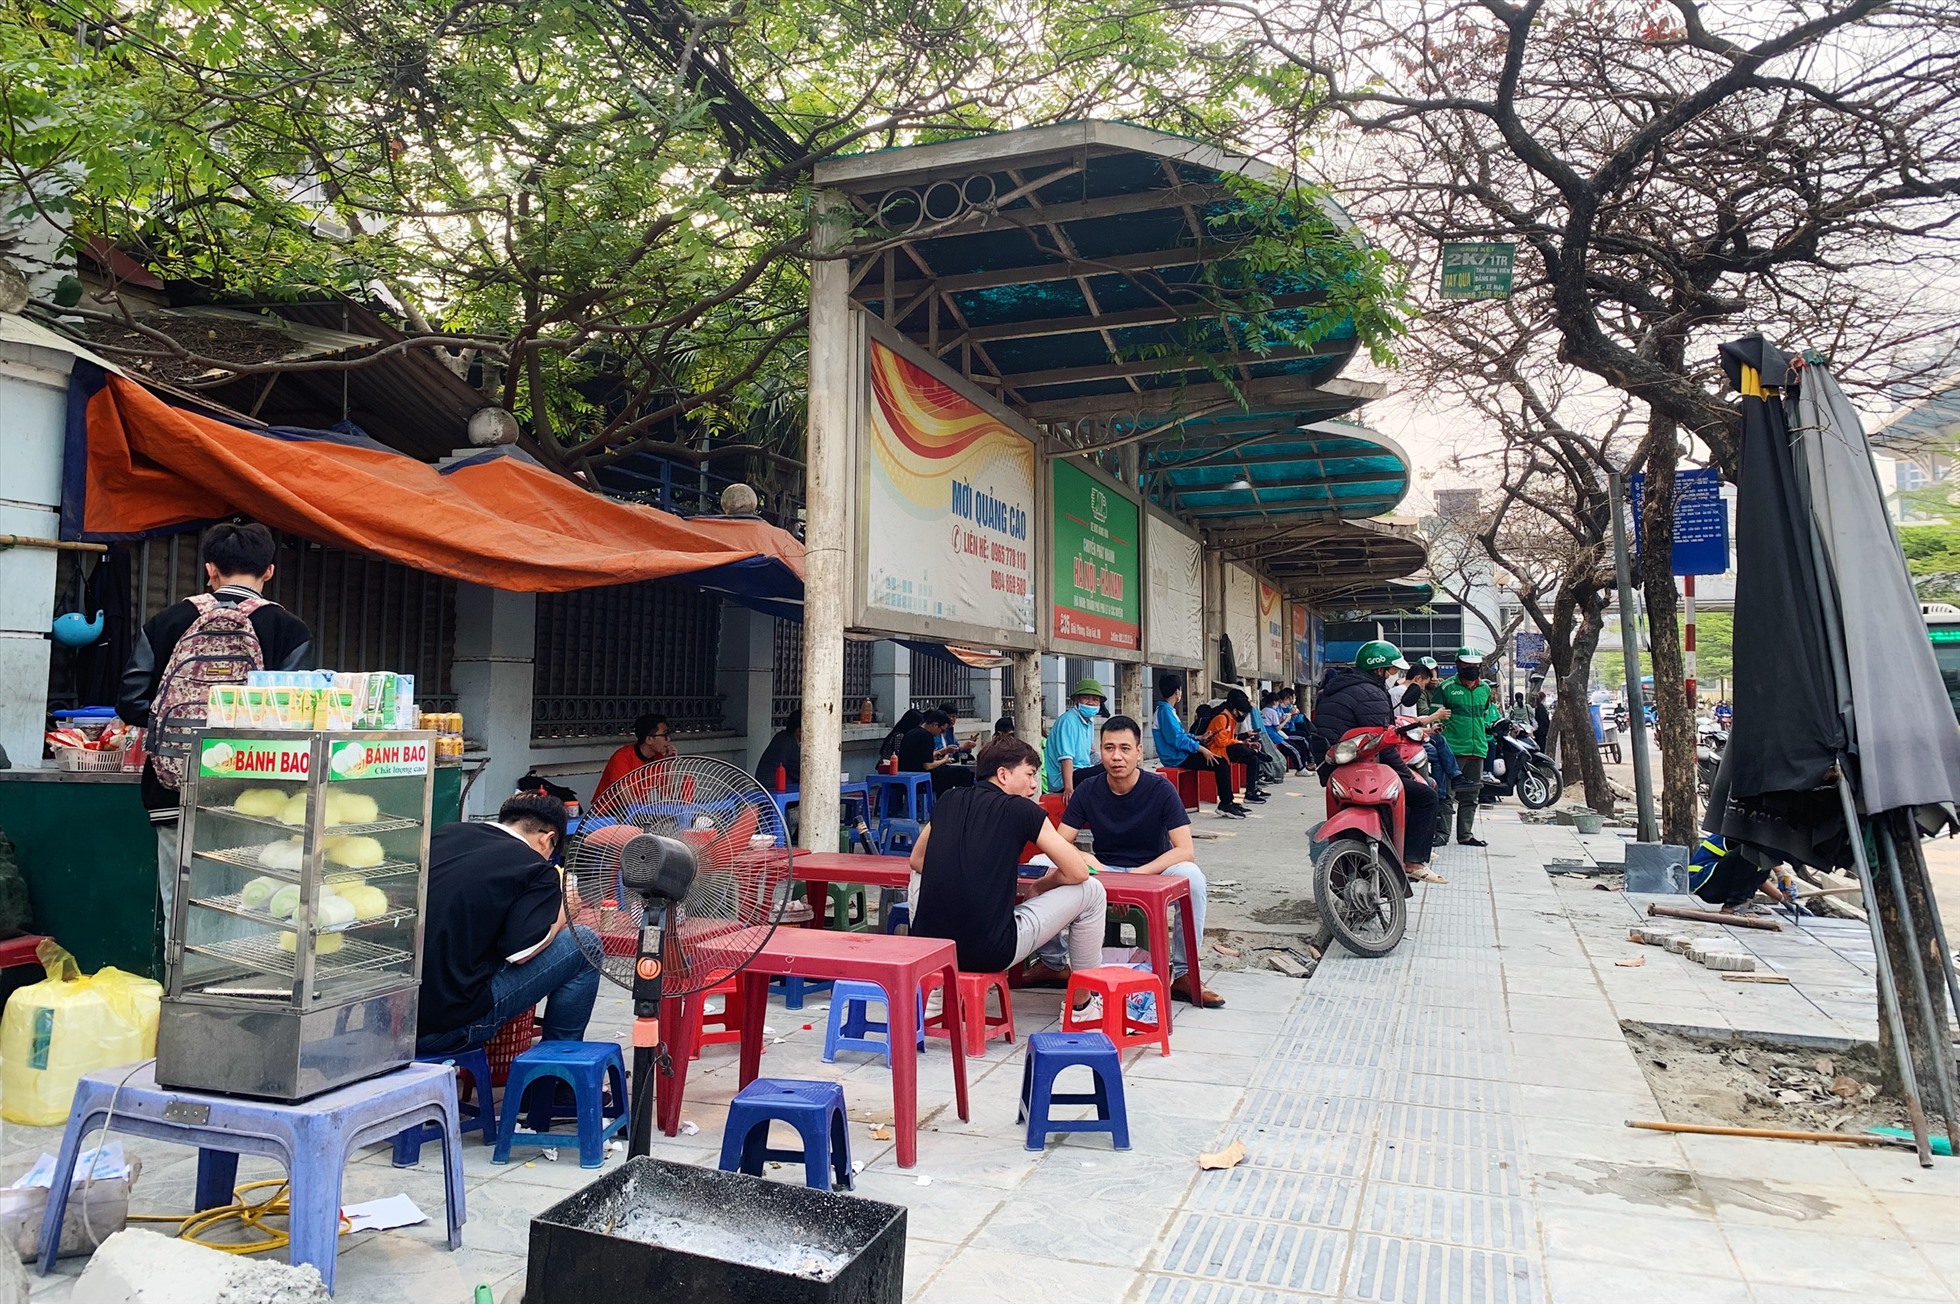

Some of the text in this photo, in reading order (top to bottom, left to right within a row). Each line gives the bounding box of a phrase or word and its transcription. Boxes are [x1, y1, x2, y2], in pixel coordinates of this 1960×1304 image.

[1444, 274, 1457, 287] VAY
[952, 476, 1026, 541] MỜI QUẢNG CÁO
[963, 530, 977, 556] LIÊN
[1073, 552, 1084, 589] HÀ
[1084, 557, 1096, 598] NỘI
[1366, 655, 1386, 665] Grab
[235, 746, 310, 774] BÁNH BAO
[366, 743, 426, 765] BÁNH BAO
[374, 765, 391, 774] Chất
[393, 766, 412, 775] lượng
